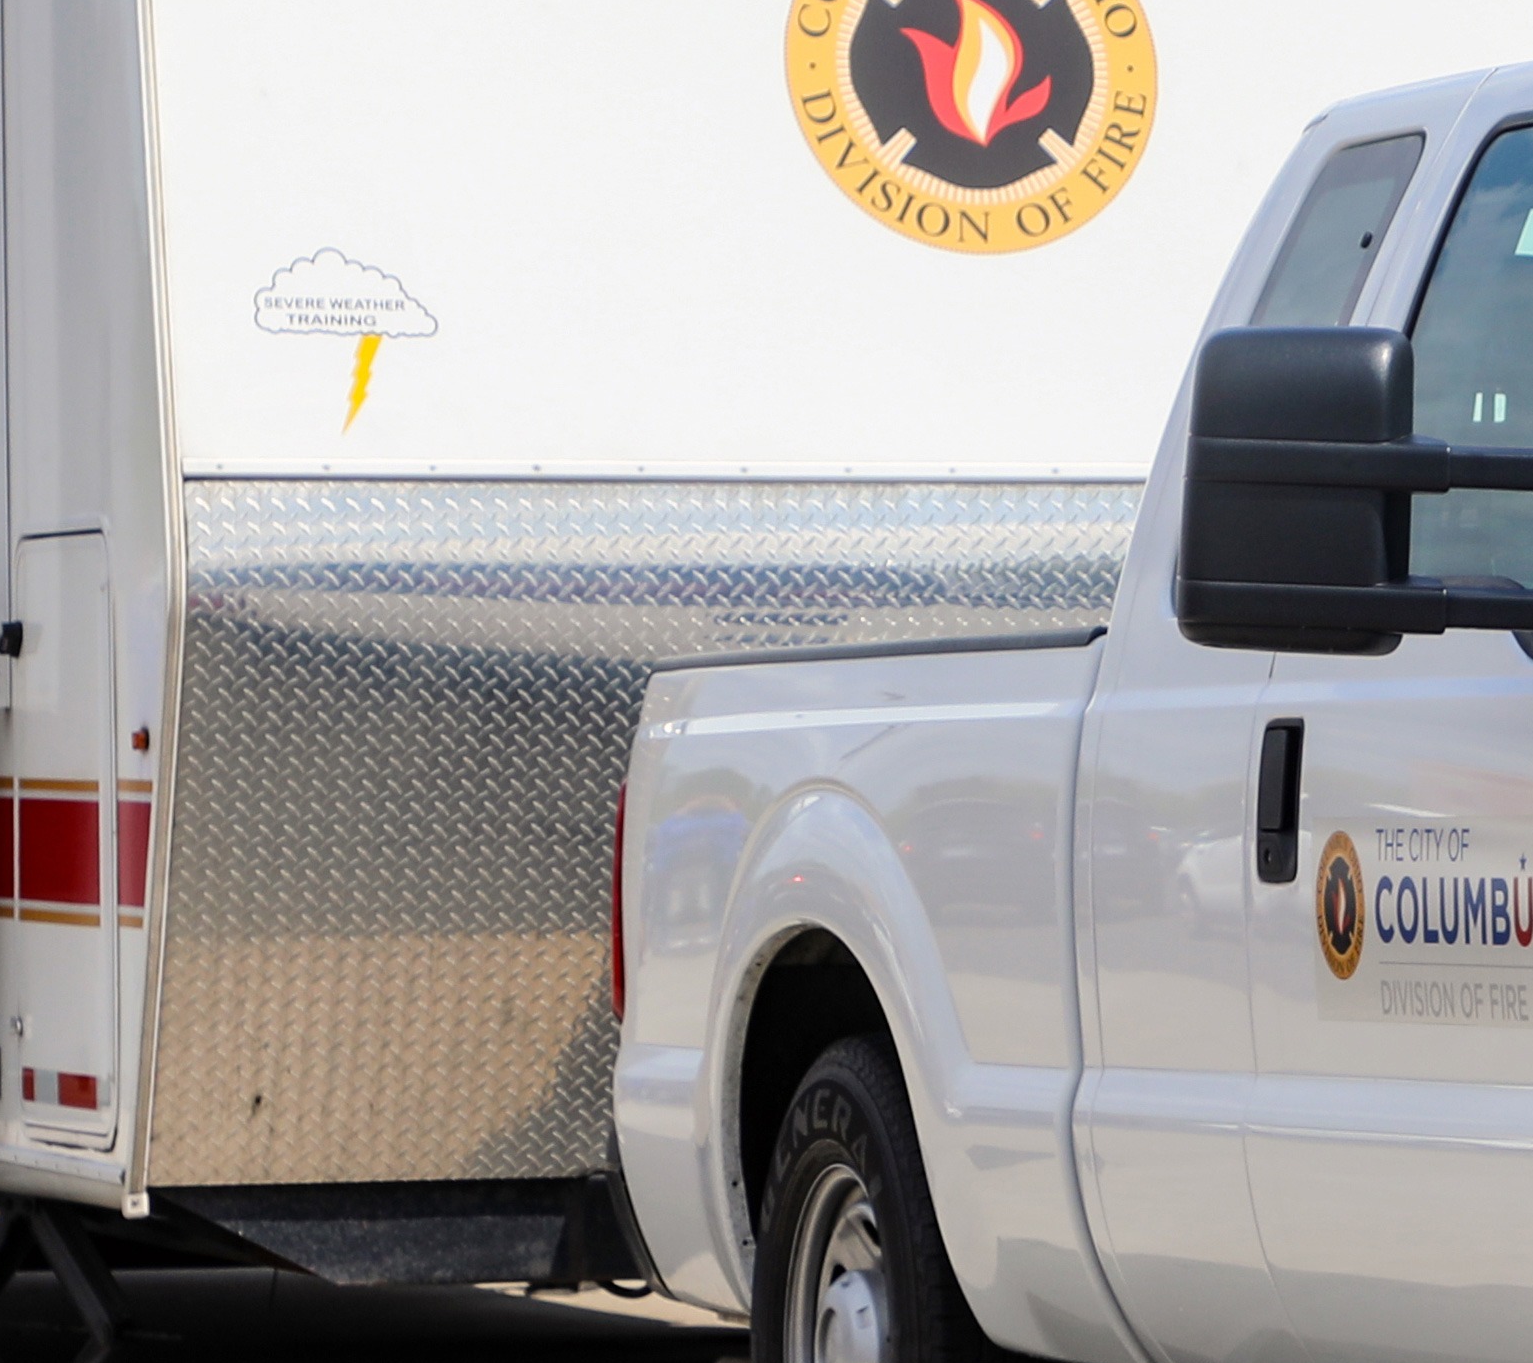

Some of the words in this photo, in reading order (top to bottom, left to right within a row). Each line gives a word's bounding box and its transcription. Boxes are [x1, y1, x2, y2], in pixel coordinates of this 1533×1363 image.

[802, 87, 990, 243] DIVISION
[1016, 187, 1075, 238] OF
[1081, 92, 1147, 194] FIRE
[263, 296, 325, 310] SEVERE
[329, 297, 406, 312] WEATHER
[286, 313, 377, 327] TRAINING
[1375, 828, 1404, 862] THE
[1407, 828, 1444, 863] CITY
[1448, 829, 1470, 863] OF
[1381, 980, 1455, 1019] DIVISION
[1461, 983, 1484, 1021] OF
[1491, 984, 1530, 1022] FIRE
